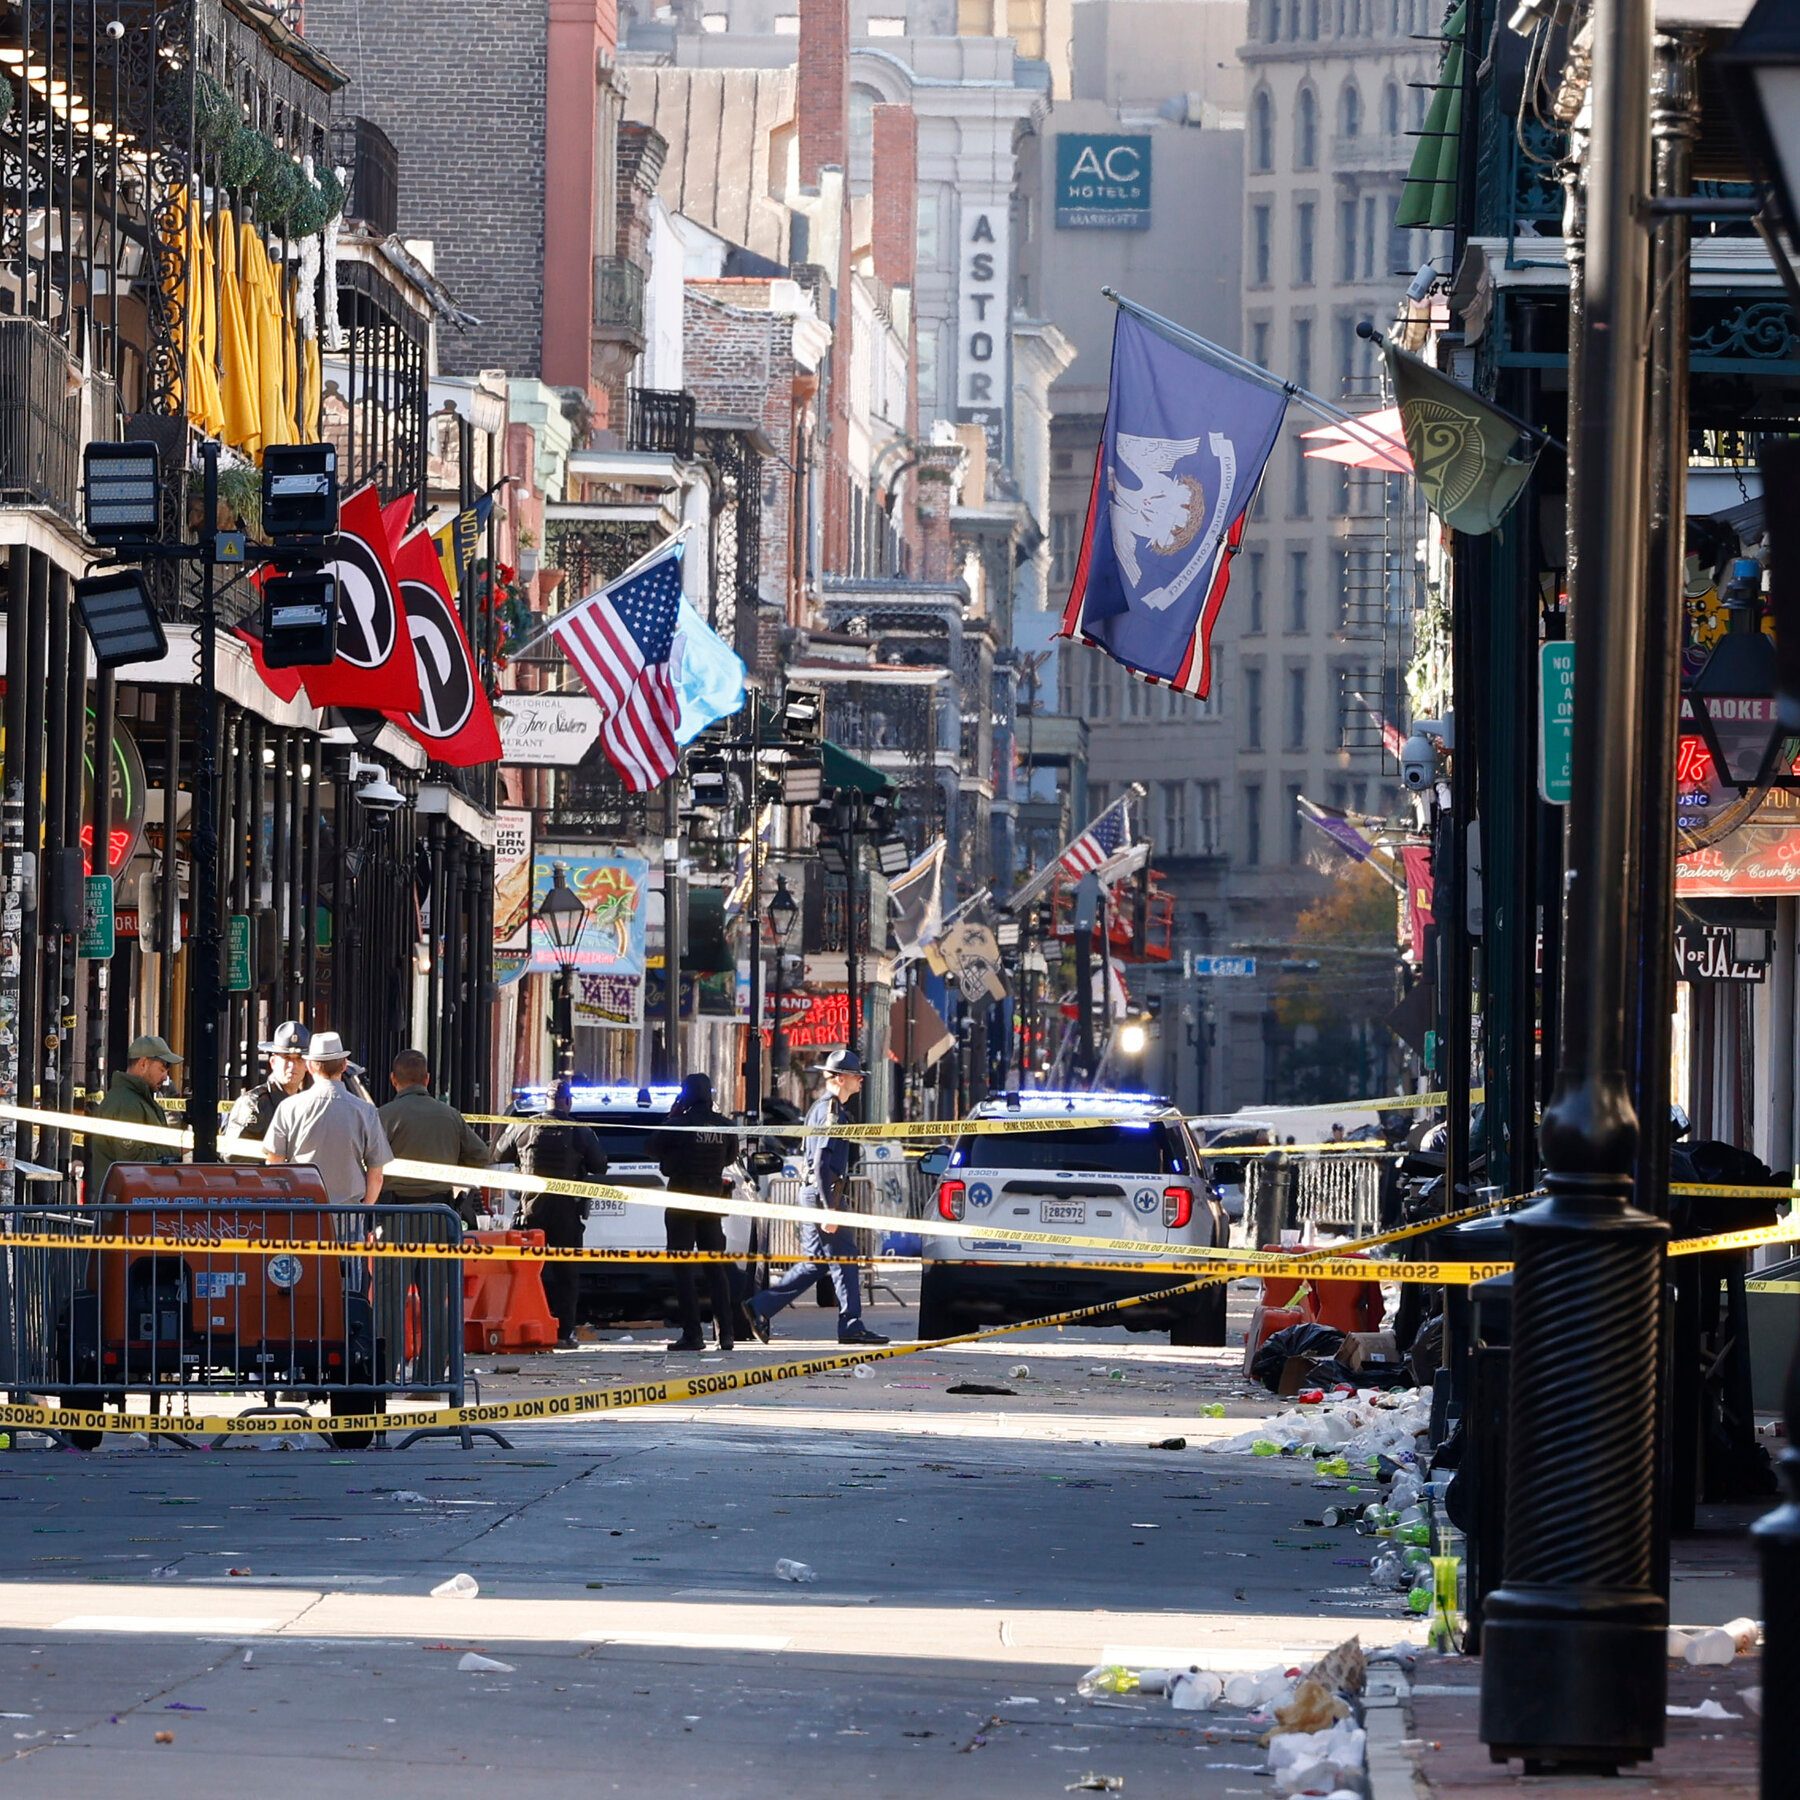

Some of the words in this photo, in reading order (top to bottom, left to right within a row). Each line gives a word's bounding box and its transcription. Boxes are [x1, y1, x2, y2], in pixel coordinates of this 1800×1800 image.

[1069, 146, 1141, 182] AC
[1069, 186, 1141, 198] HOTELS
[970, 214, 996, 401] ASTOR
[1553, 657, 1571, 669] NO
[1680, 699, 1762, 719] AAOKE
[549, 710, 587, 735] Sisters
[502, 739, 544, 748] AURANT
[497, 830, 524, 839] URT
[497, 838, 526, 847] ERN
[497, 847, 526, 856] BOY
[1676, 864, 1738, 882] Balcony
[579, 981, 602, 1004] YA
[608, 985, 632, 1008] YA
[865, 1126, 883, 1136] CROSS
[908, 1125, 925, 1135] CRIME
[925, 1124, 942, 1134] SCENE
[942, 1123, 950, 1134] DO
[950, 1123, 960, 1134] NOT
[961, 1122, 978, 1133] CROSS
[1003, 1122, 1020, 1131] CRIME
[1020, 1122, 1036, 1131] SCENE
[1055, 1120, 1075, 1129] CROSS
[1048, 1207, 1083, 1218] 282972
[47, 1234, 85, 1243] LINE
[93, 1236, 115, 1244] DO
[163, 1237, 222, 1248] CROSS
[248, 1239, 311, 1250] POLICE
[317, 1241, 357, 1251] LINE
[364, 1242, 387, 1252] DO
[393, 1243, 427, 1253] NOT
[435, 1243, 494, 1255] CROSS
[520, 1246, 584, 1257] POLICE
[590, 1248, 630, 1258] LINE
[636, 1250, 661, 1259] DO
[743, 1369, 773, 1388] NOT
[778, 1366, 799, 1381] DO
[688, 1373, 738, 1396] CROSS
[576, 1394, 608, 1411] LINE
[613, 1384, 667, 1406] POLICE
[514, 1402, 544, 1418] NOT
[549, 1398, 570, 1414] DO
[49, 1411, 81, 1427] NOT
[85, 1413, 106, 1428] DO
[382, 1412, 437, 1427] POLICE
[459, 1406, 509, 1422] CROSS
[112, 1415, 146, 1430] LINE
[150, 1417, 204, 1431] POLICE
[227, 1419, 277, 1431] CROSS
[282, 1419, 313, 1431] NOT
[318, 1418, 339, 1430] DO
[344, 1416, 378, 1429] LINE
